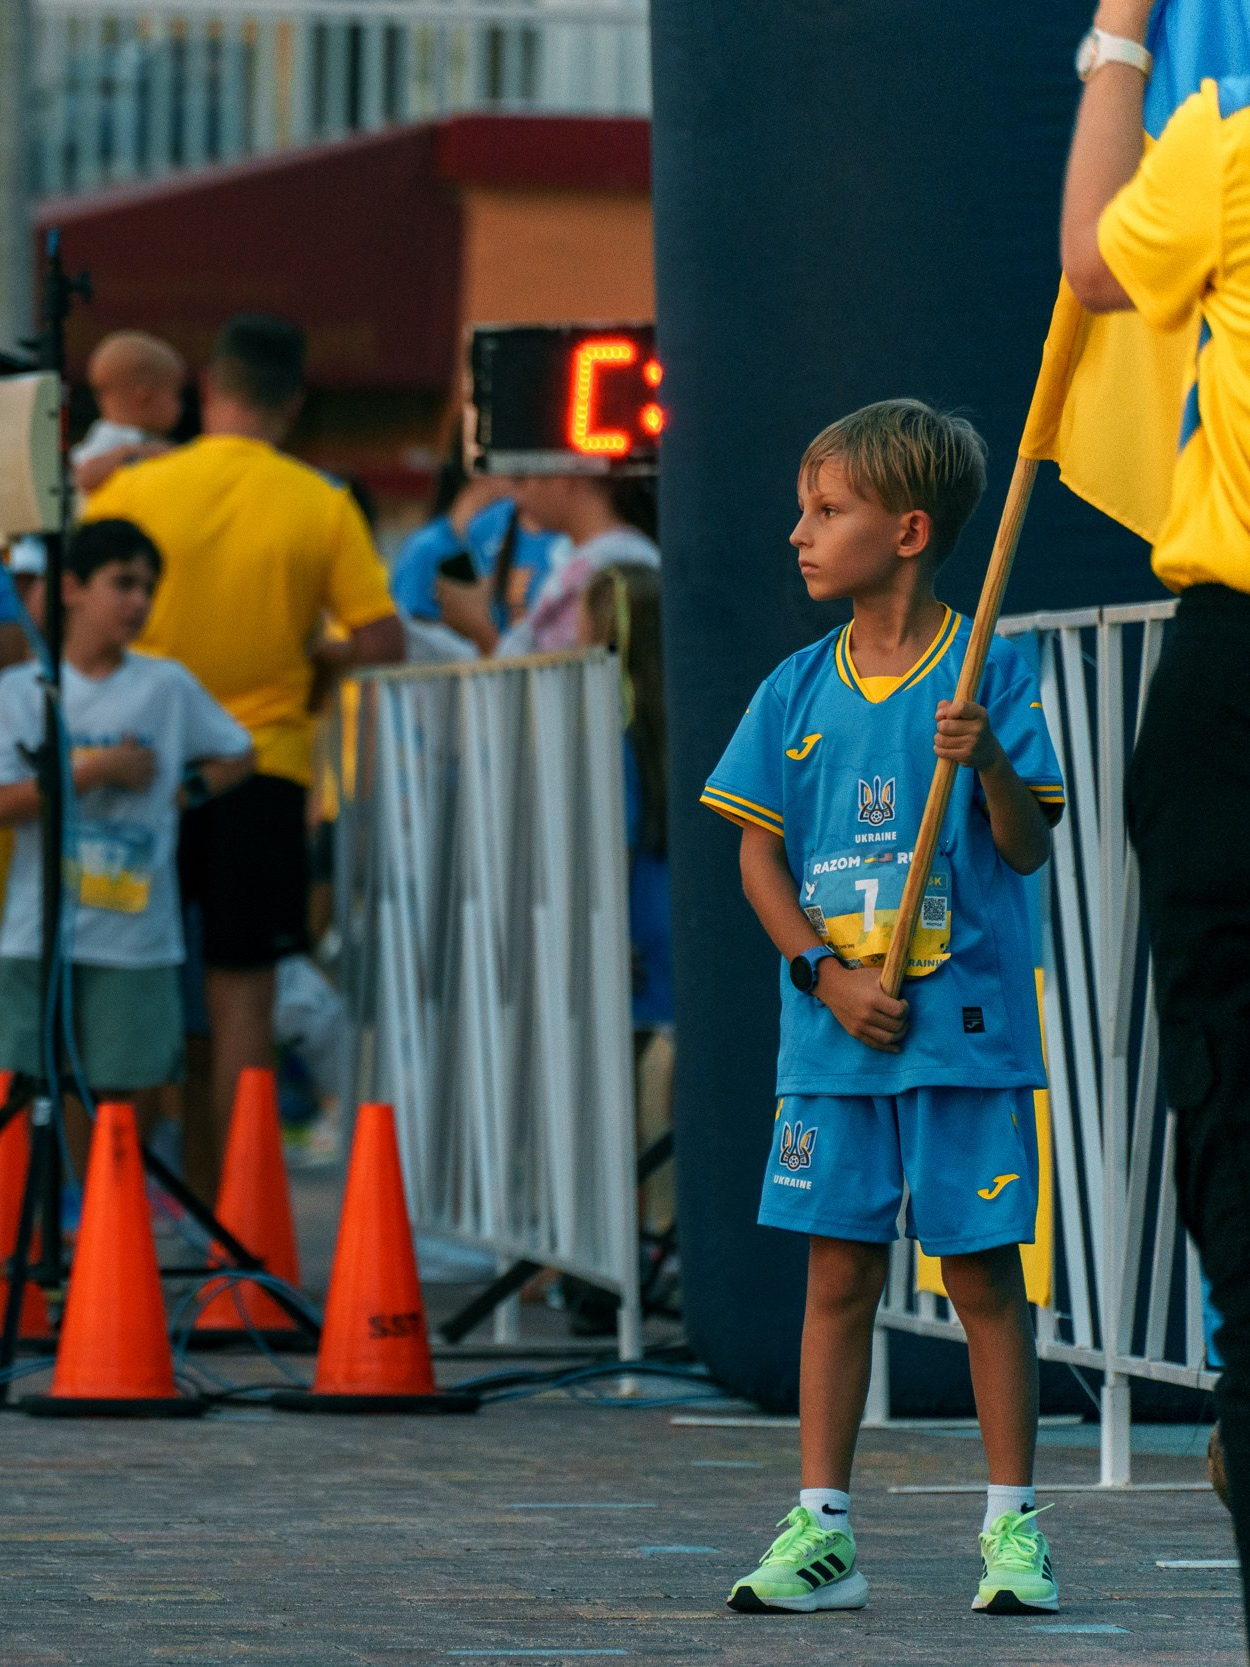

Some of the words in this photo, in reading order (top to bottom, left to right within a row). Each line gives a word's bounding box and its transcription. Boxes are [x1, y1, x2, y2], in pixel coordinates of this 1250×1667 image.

[854, 831, 897, 844] UKRAINE
[812, 855, 861, 876] RAZOM
[773, 1174, 813, 1190] UKRAINE
